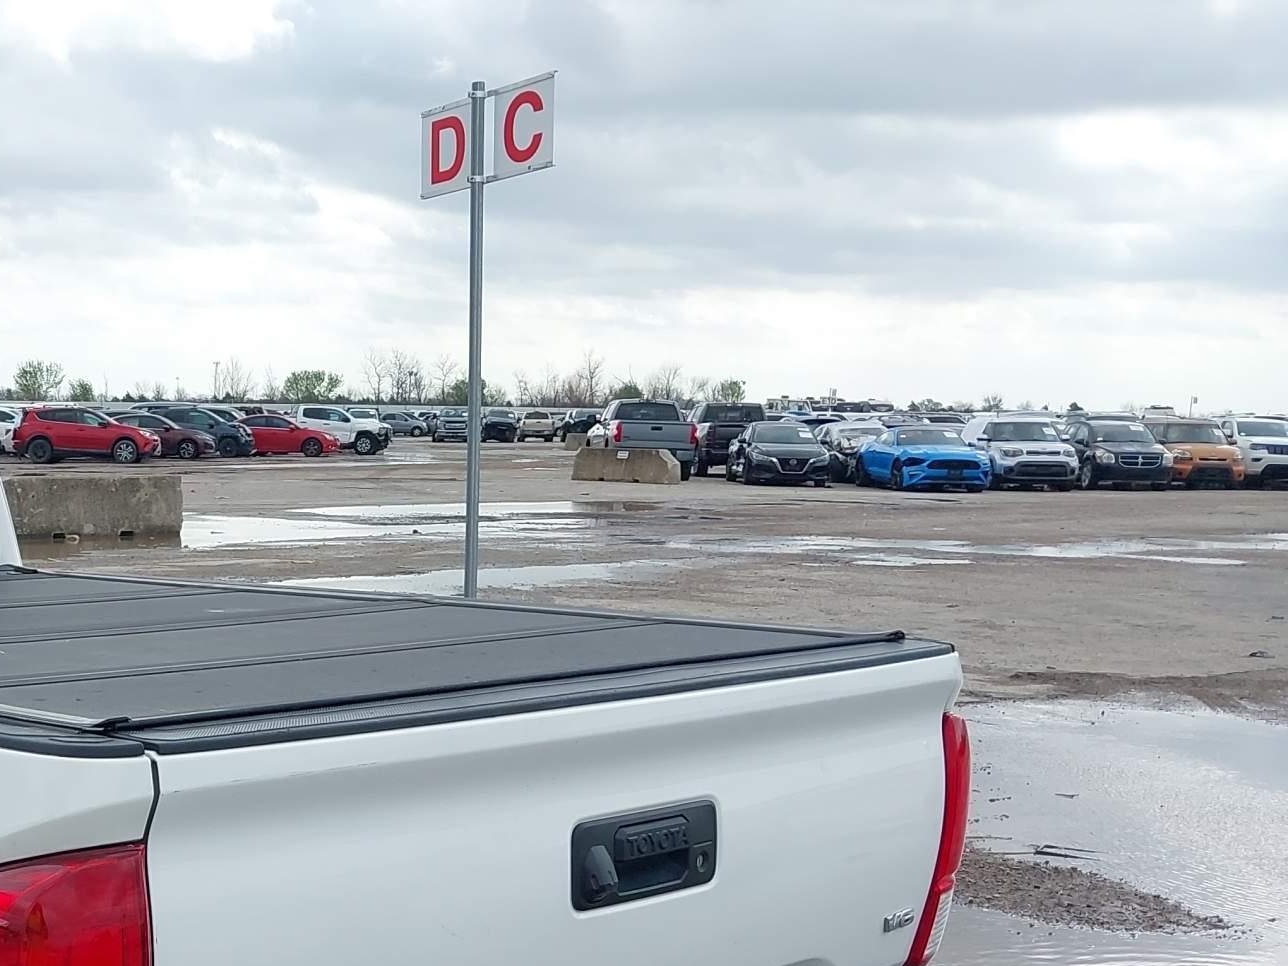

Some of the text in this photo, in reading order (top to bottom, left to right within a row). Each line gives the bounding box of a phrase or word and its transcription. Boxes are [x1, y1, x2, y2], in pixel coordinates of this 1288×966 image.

[431, 116, 466, 185] D
[504, 90, 544, 163] C
[626, 826, 690, 857] TOYOTA
